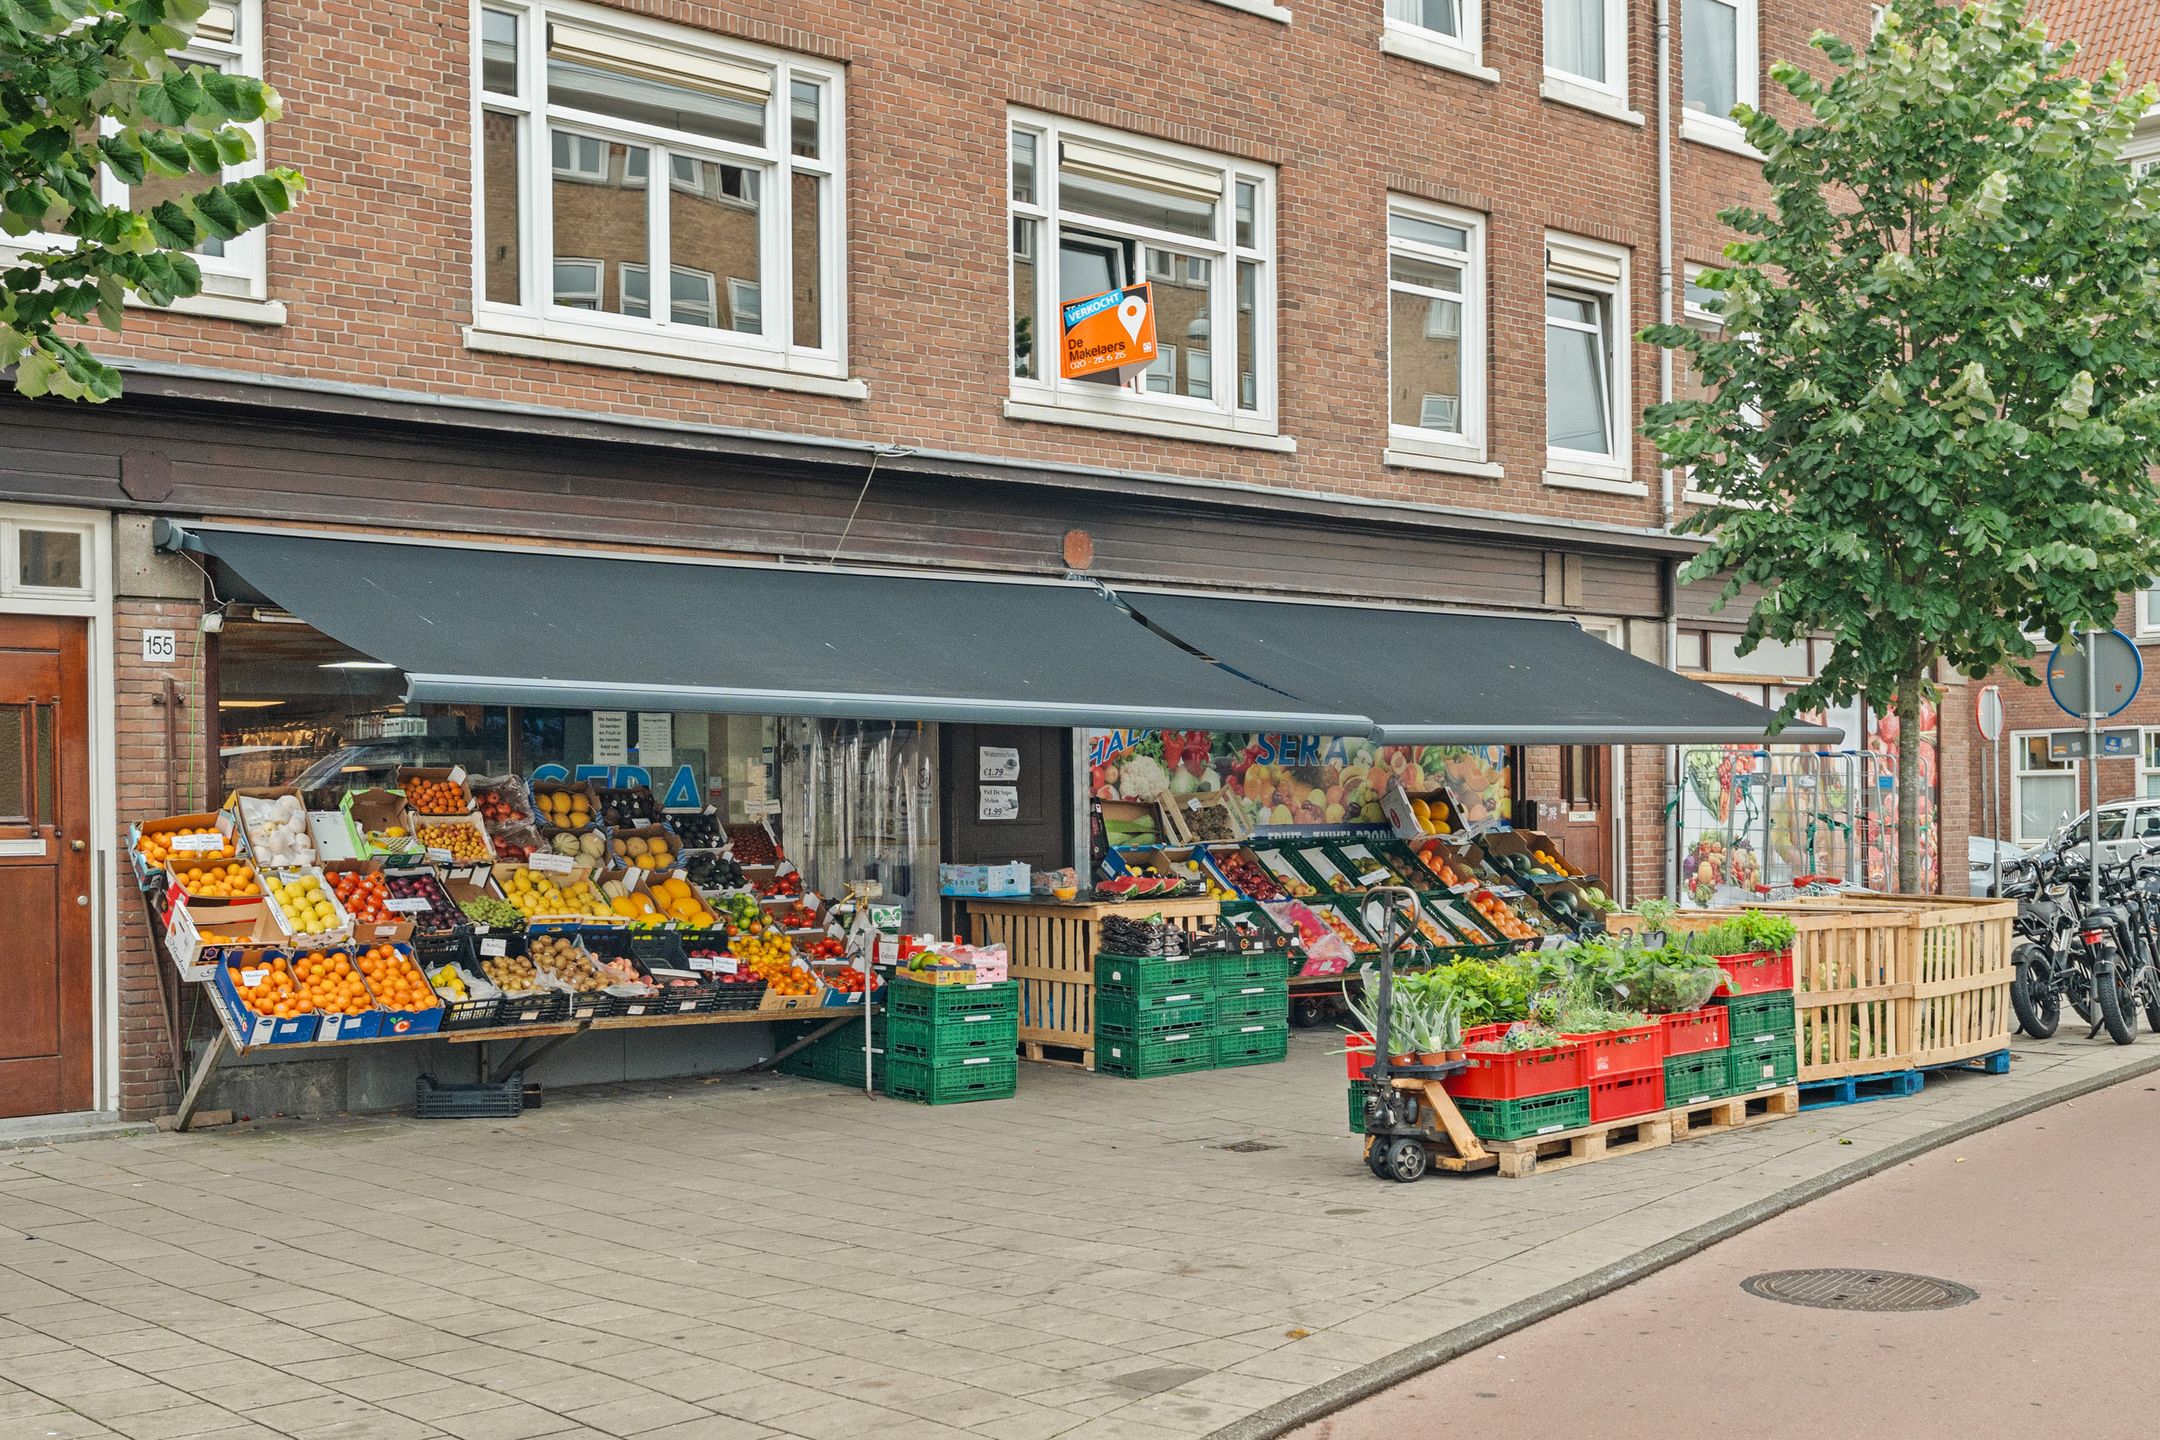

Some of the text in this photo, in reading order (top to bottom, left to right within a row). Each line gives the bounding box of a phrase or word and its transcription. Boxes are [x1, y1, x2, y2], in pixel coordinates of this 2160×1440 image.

[1068, 292, 1120, 322] VERKOCHT
[1068, 338, 1084, 350] De
[1069, 340, 1126, 362] Makelaers
[1070, 359, 1087, 370] 020
[145, 635, 173, 656] 155
[1089, 728, 1162, 766] HAL
[1255, 732, 1350, 767] SERA
[983, 767, 1004, 777] €1.79
[982, 808, 1003, 816] €1.99
